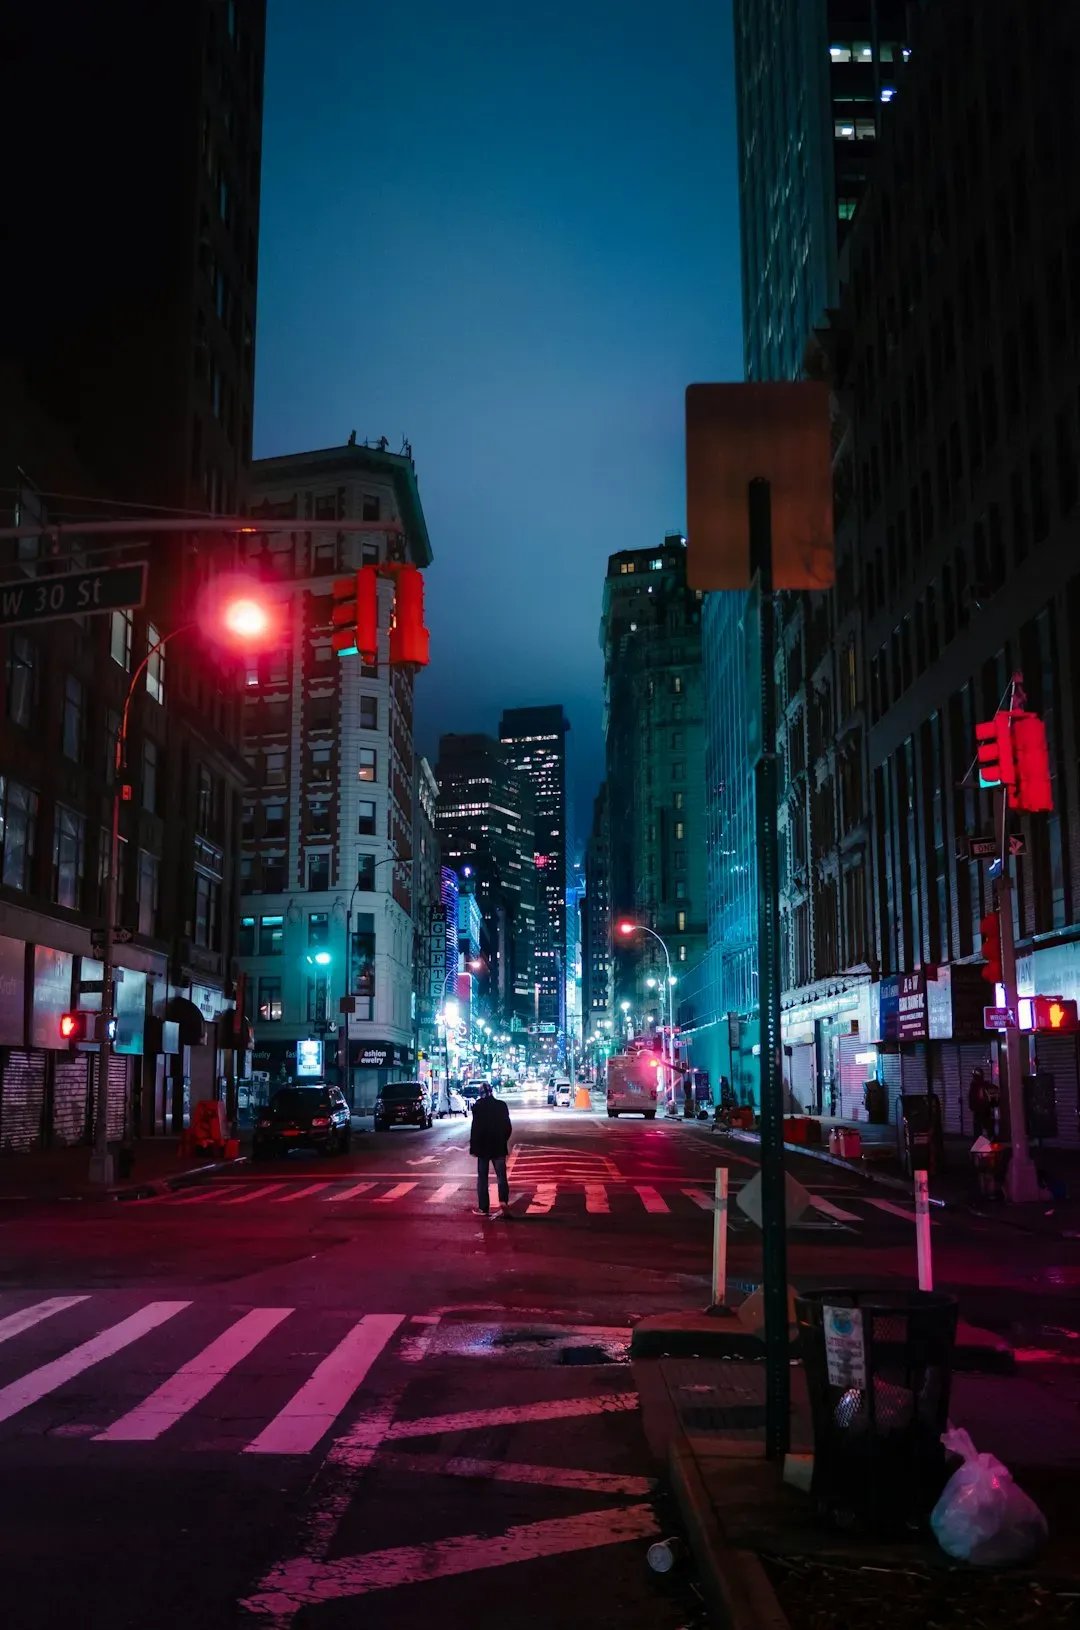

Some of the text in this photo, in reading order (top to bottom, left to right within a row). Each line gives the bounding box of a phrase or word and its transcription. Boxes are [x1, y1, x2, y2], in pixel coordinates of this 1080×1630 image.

[2, 577, 102, 616] W 30 St
[432, 923, 443, 994] GIFTS
